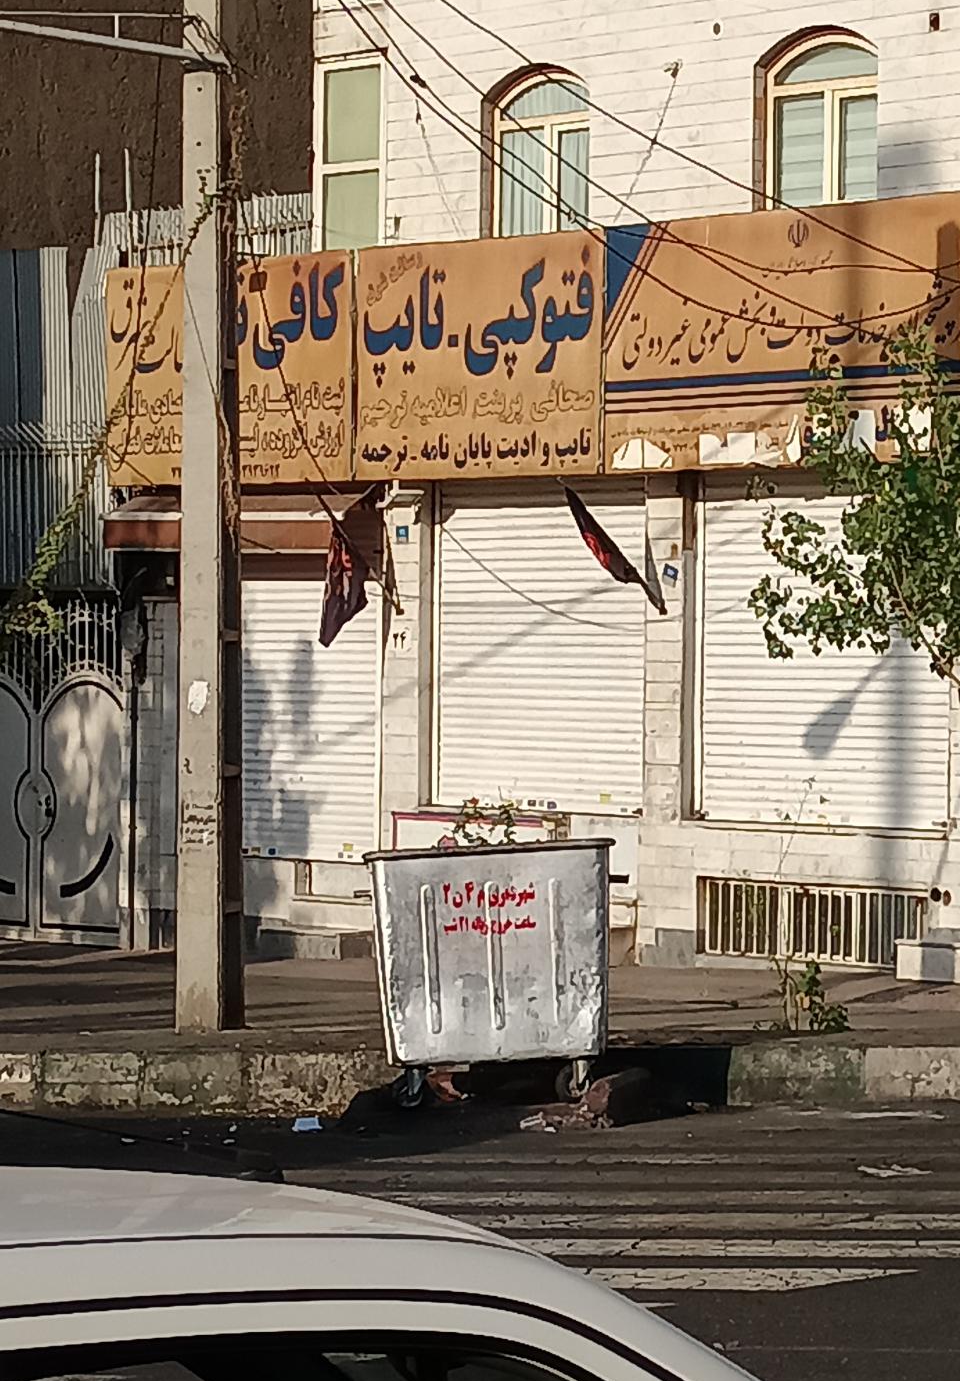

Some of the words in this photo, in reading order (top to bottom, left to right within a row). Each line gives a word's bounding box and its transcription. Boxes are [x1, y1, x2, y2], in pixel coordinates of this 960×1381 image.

[254, 261, 346, 370] کافی
[363, 265, 447, 389] تایپ
[464, 243, 594, 378] فتوکپی
[361, 435, 408, 472] ترجمه
[419, 433, 450, 462] نامه
[453, 432, 493, 469] پایان
[496, 430, 537, 465] ادیت
[539, 443, 550, 467] و
[554, 428, 592, 468] تایپ
